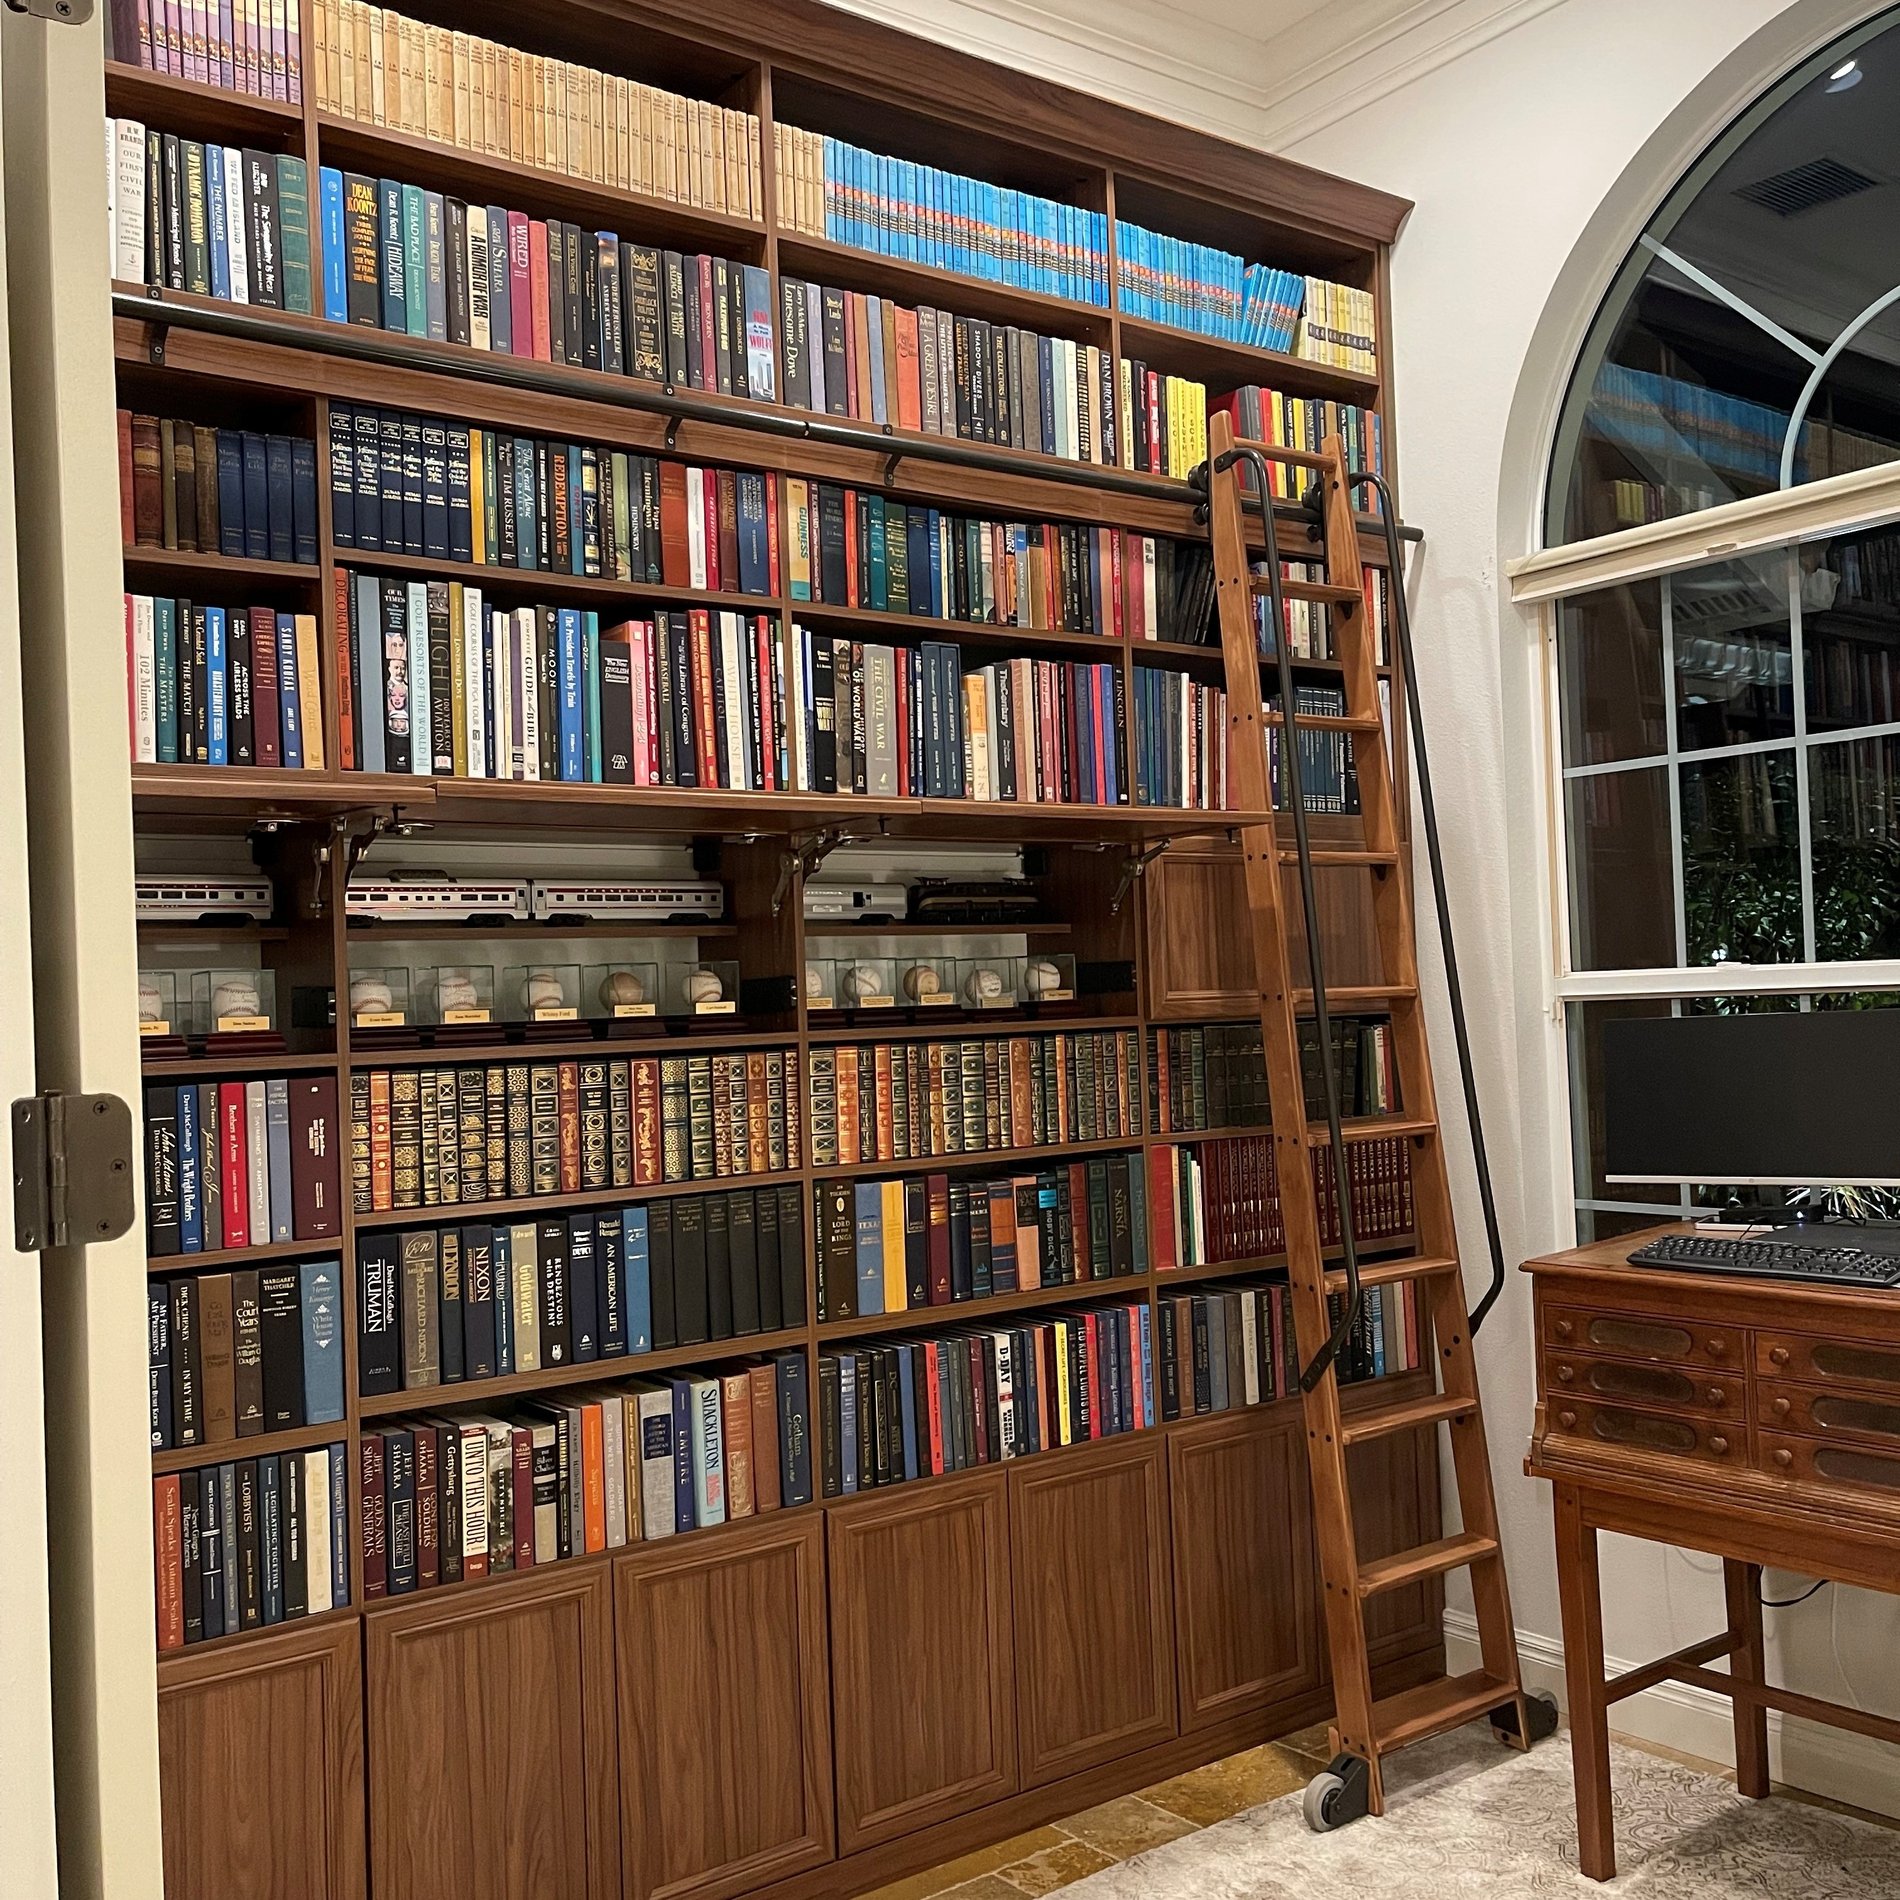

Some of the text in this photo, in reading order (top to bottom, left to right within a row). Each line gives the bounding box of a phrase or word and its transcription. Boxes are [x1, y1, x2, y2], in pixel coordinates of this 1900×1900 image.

[120, 162, 143, 172] FIRST
[120, 175, 142, 185] CIVIL
[124, 150, 142, 159] OUR
[124, 187, 141, 197] WAR
[170, 207, 179, 242] Municipal
[215, 204, 224, 241] NUMBER
[410, 196, 420, 263] THE BAD PLACE
[517, 225, 528, 267] WIRED
[172, 243, 181, 265] Bonds
[387, 245, 404, 300] HIDEAWAY
[471, 235, 488, 318] A RUMOR OF WAR
[493, 247, 507, 292] SAHARA
[784, 283, 797, 378] Lonesome Dove
[924, 334, 936, 416] A GREEN DESIRE
[1102, 354, 1112, 420] DAN BROWN
[523, 449, 533, 518] The Great Alone
[554, 455, 567, 539] REDEMPTION
[643, 472, 652, 529] Hemingway
[503, 473, 513, 546] TIM RUSSERT
[631, 506, 639, 551] HEMINGWAY
[799, 507, 809, 559] GUINNESS
[335, 578, 348, 653] DECORATING
[565, 616, 574, 627] The
[281, 628, 294, 691] SANDY KOUFAX
[430, 615, 450, 697] FLIGHT
[549, 648, 557, 688] MOON
[565, 629, 575, 658] President
[658, 616, 669, 704] Smithsonian BASEBALL
[139, 654, 151, 721] 102 Minutes
[414, 600, 427, 754] GOLF RESORTS OF THE WORLD
[565, 660, 575, 681] Travels
[679, 666, 688, 695] Library
[853, 671, 860, 683] OF
[434, 697, 445, 751] AVIATION
[567, 692, 575, 707] Train
[853, 686, 861, 717] WORLD
[874, 657, 885, 749] THE CIVIL WAR
[1116, 679, 1124, 728] LINCOLN
[526, 712, 535, 748] BIBLE
[681, 707, 690, 744] Congress
[853, 721, 861, 741] WAR
[184, 1115, 192, 1152] McCullough
[229, 1105, 237, 1133] Brothers
[181, 1158, 195, 1222] The Wright Brothers
[1114, 1188, 1124, 1238] NARNIA
[476, 1246, 490, 1302] NIXON
[607, 1243, 614, 1258] AN
[367, 1259, 382, 1332] TRUMAN
[386, 1265, 395, 1324] David McCullough
[519, 1264, 534, 1325] Goldwater
[547, 1282, 555, 1327] DESTINY
[554, 1258, 563, 1325] RENDEZVOUS
[608, 1260, 616, 1309] AMERICAN
[151, 1301, 160, 1356] MY PRESIDENT
[180, 1286, 190, 1341] DICK CHENEY
[416, 1277, 426, 1363] RICHARD NIXON
[889, 1372, 897, 1389] DC
[1000, 1347, 1010, 1383] D-DAY
[183, 1369, 192, 1422] IN MY TIME
[700, 1389, 720, 1470] SHACKLETON
[793, 1414, 803, 1456] Gotham
[363, 1446, 373, 1484] SHAARA
[374, 1453, 383, 1473] JEFF
[392, 1444, 402, 1489] SHAARA
[403, 1452, 412, 1477] JEFF
[419, 1440, 427, 1482] SHAARA
[445, 1446, 456, 1496] Gettysburg
[679, 1430, 689, 1485] EMPIRE
[242, 1482, 252, 1533] LOBBYISTS
[334, 1456, 344, 1513] Newt Gingrich
[465, 1441, 486, 1546] UNTO THIS HOUR
[573, 1460, 582, 1513] Hillbilly Elegy
[166, 1487, 176, 1550] Scalia Speaks
[363, 1496, 374, 1557] GENERALS
[374, 1495, 384, 1554] GODS AND
[423, 1497, 431, 1547] SOLDIERS
[169, 1560, 178, 1630] Antonin Scalia
